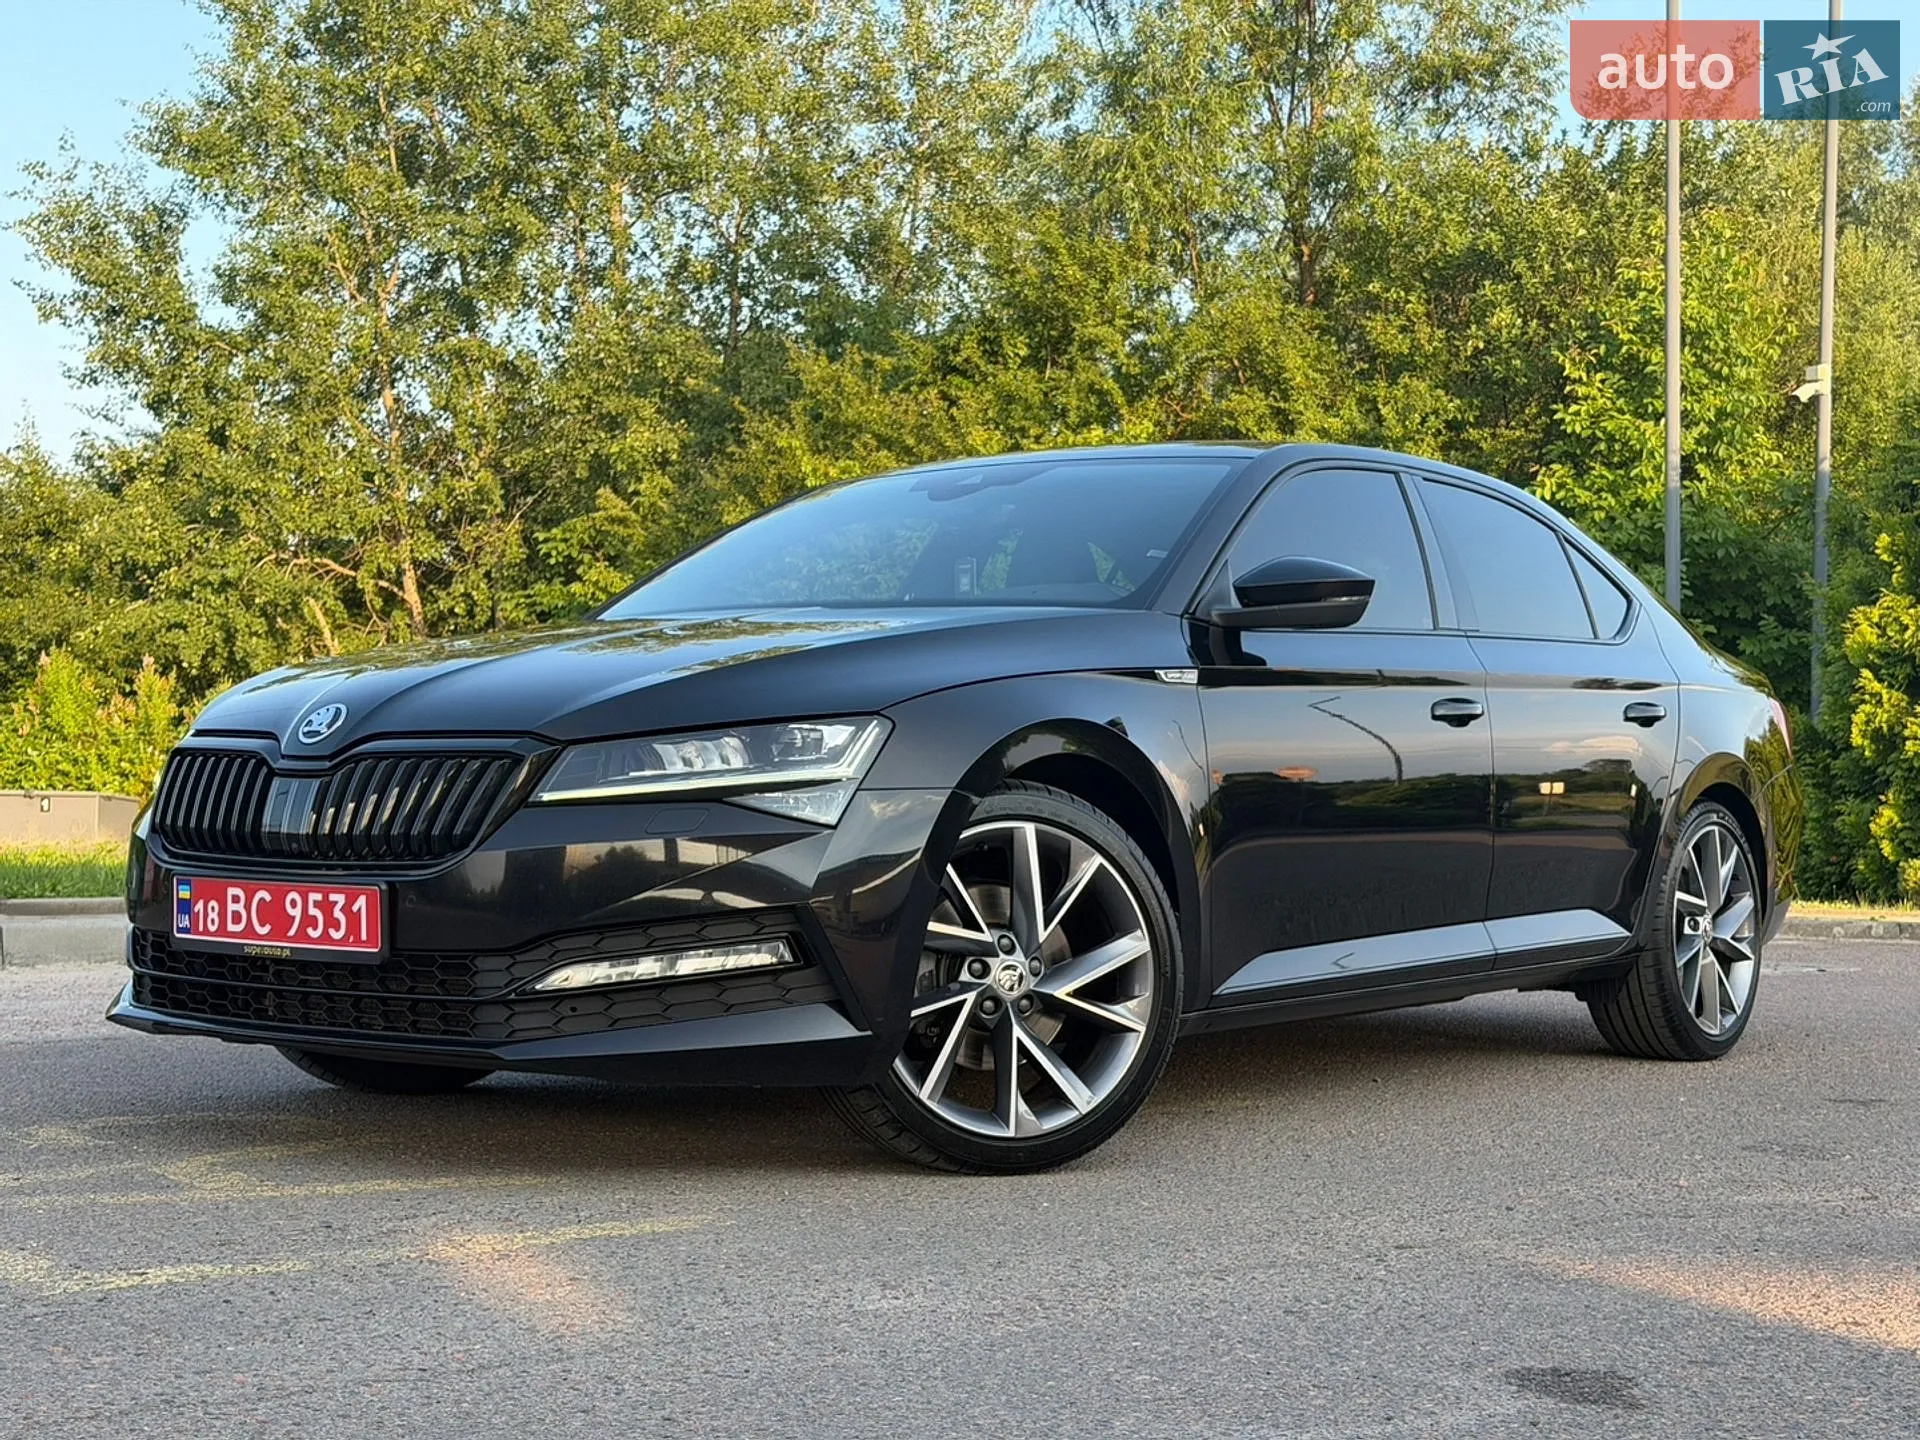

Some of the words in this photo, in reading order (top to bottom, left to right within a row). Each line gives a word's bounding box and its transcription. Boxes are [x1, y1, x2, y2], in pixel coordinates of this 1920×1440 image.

[178, 913, 191, 928] UA
[194, 899, 219, 932] 18
[226, 886, 273, 936] BC
[284, 890, 368, 942] 9531
